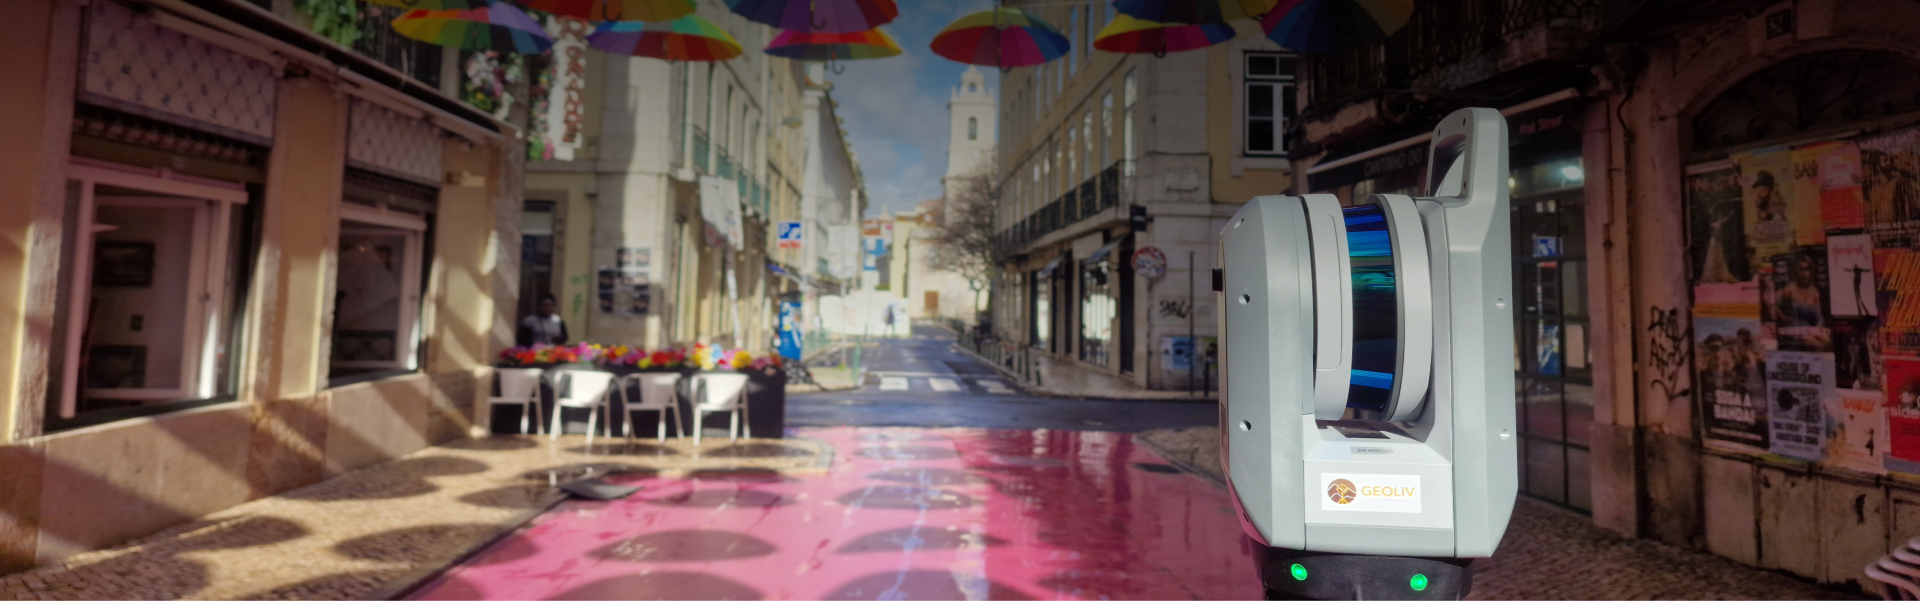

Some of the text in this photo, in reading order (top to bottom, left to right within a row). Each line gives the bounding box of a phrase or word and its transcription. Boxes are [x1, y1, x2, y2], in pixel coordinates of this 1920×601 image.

[1538, 114, 1563, 131] Street
[1364, 152, 1405, 177] CANTINHO
[1408, 147, 1423, 166] DO
[1361, 485, 1416, 498] GEOLIV
